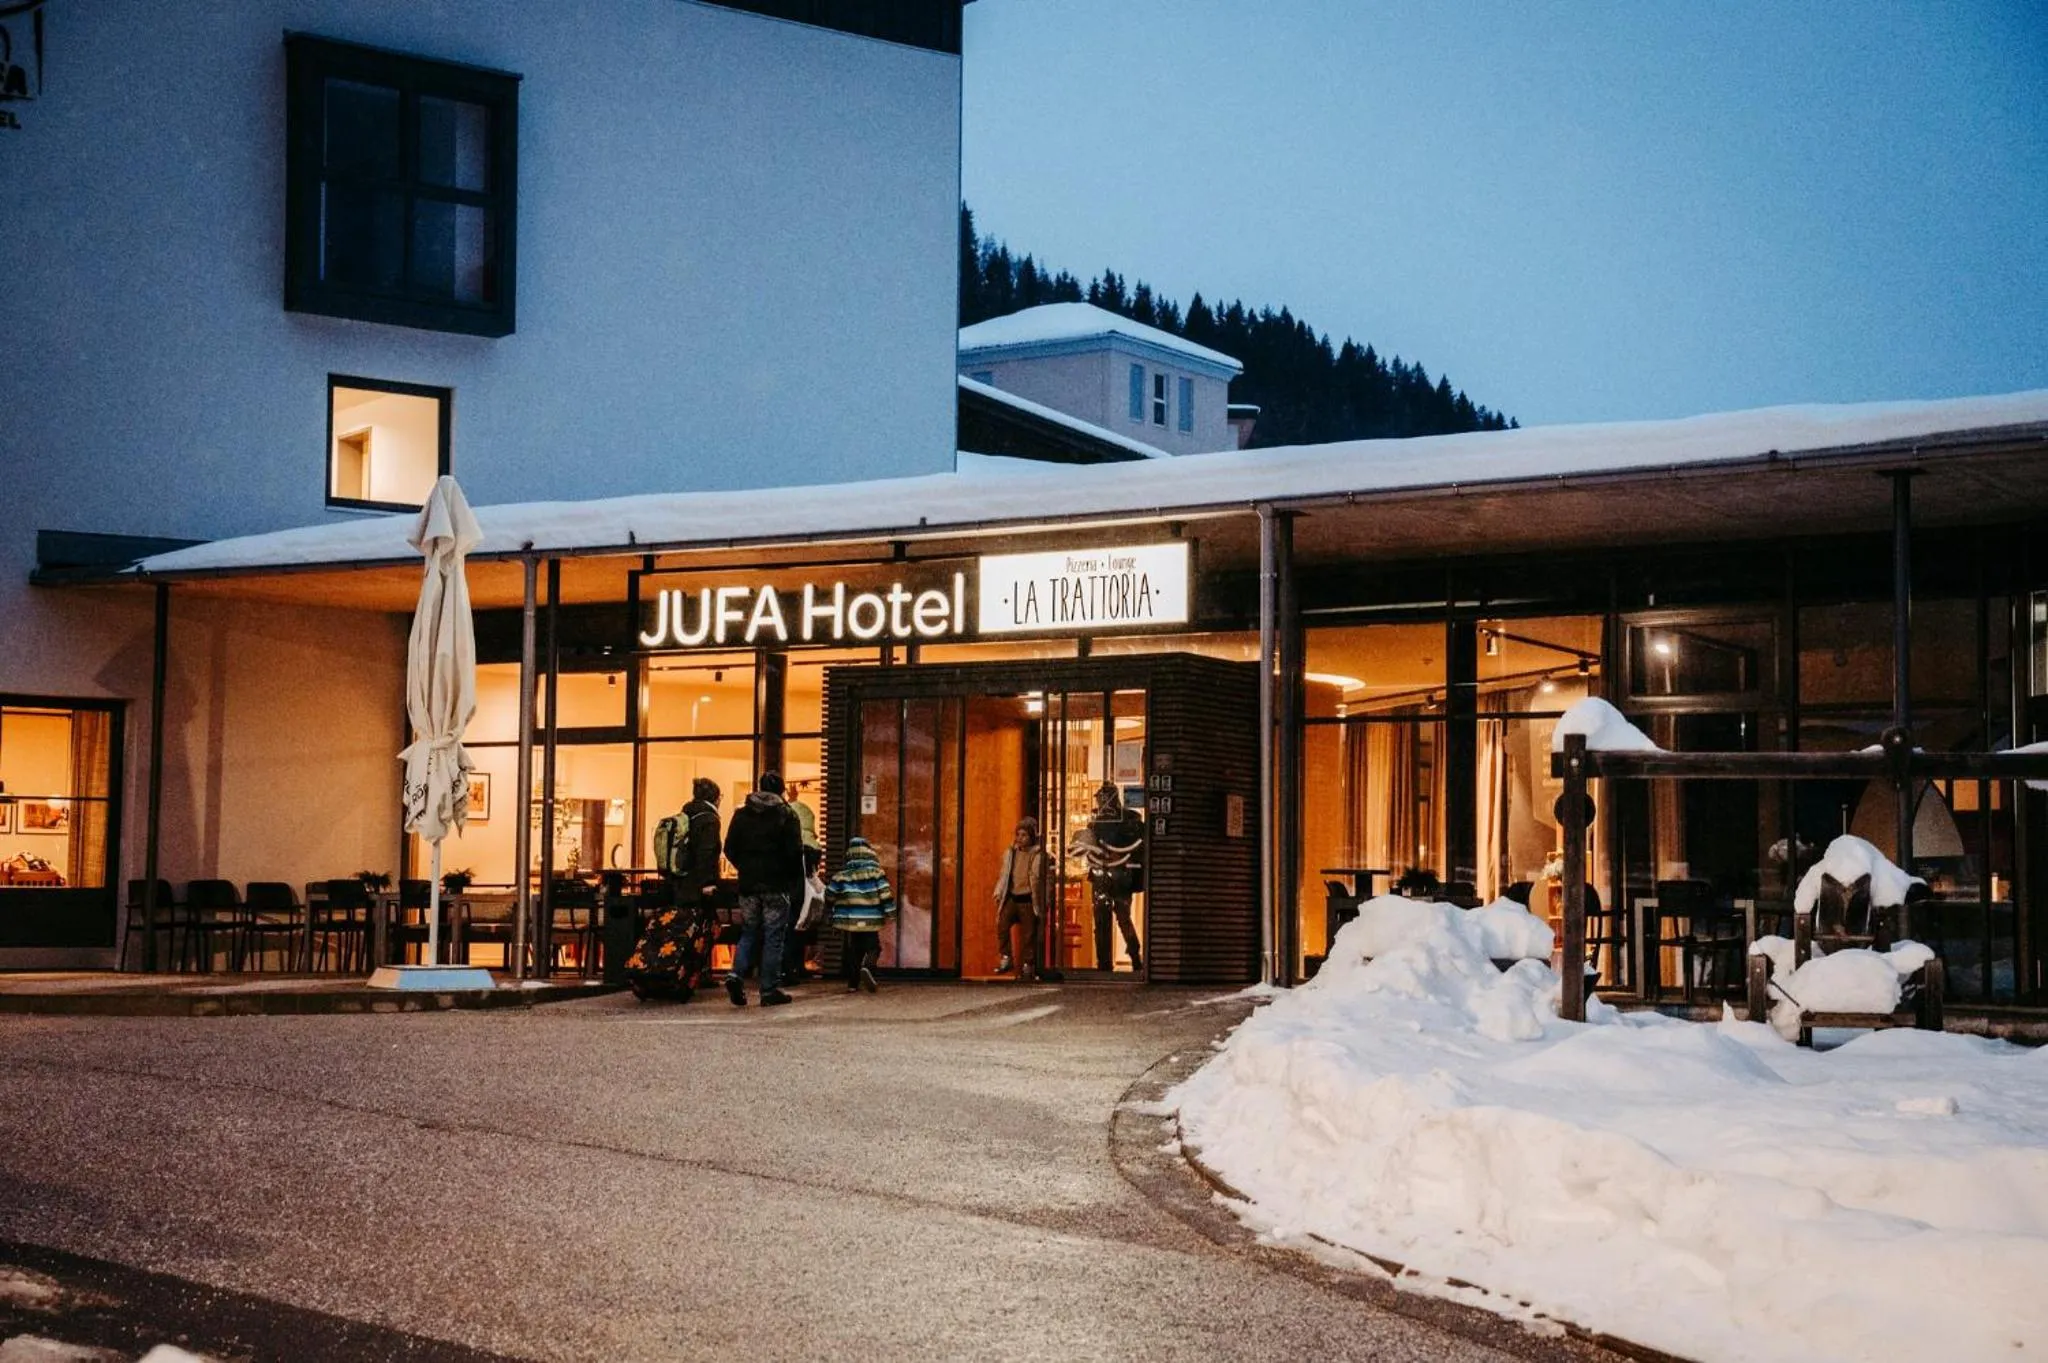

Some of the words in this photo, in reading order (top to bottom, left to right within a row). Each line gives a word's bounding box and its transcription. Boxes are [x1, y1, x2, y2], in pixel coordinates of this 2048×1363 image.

[1066, 556, 1097, 573] Pizzeria
[1107, 553, 1136, 573] Lounge
[639, 583, 789, 647] JUFA
[802, 571, 966, 640] Hotel
[1013, 579, 1040, 625] LA
[1049, 572, 1153, 623] TRATTORIA
